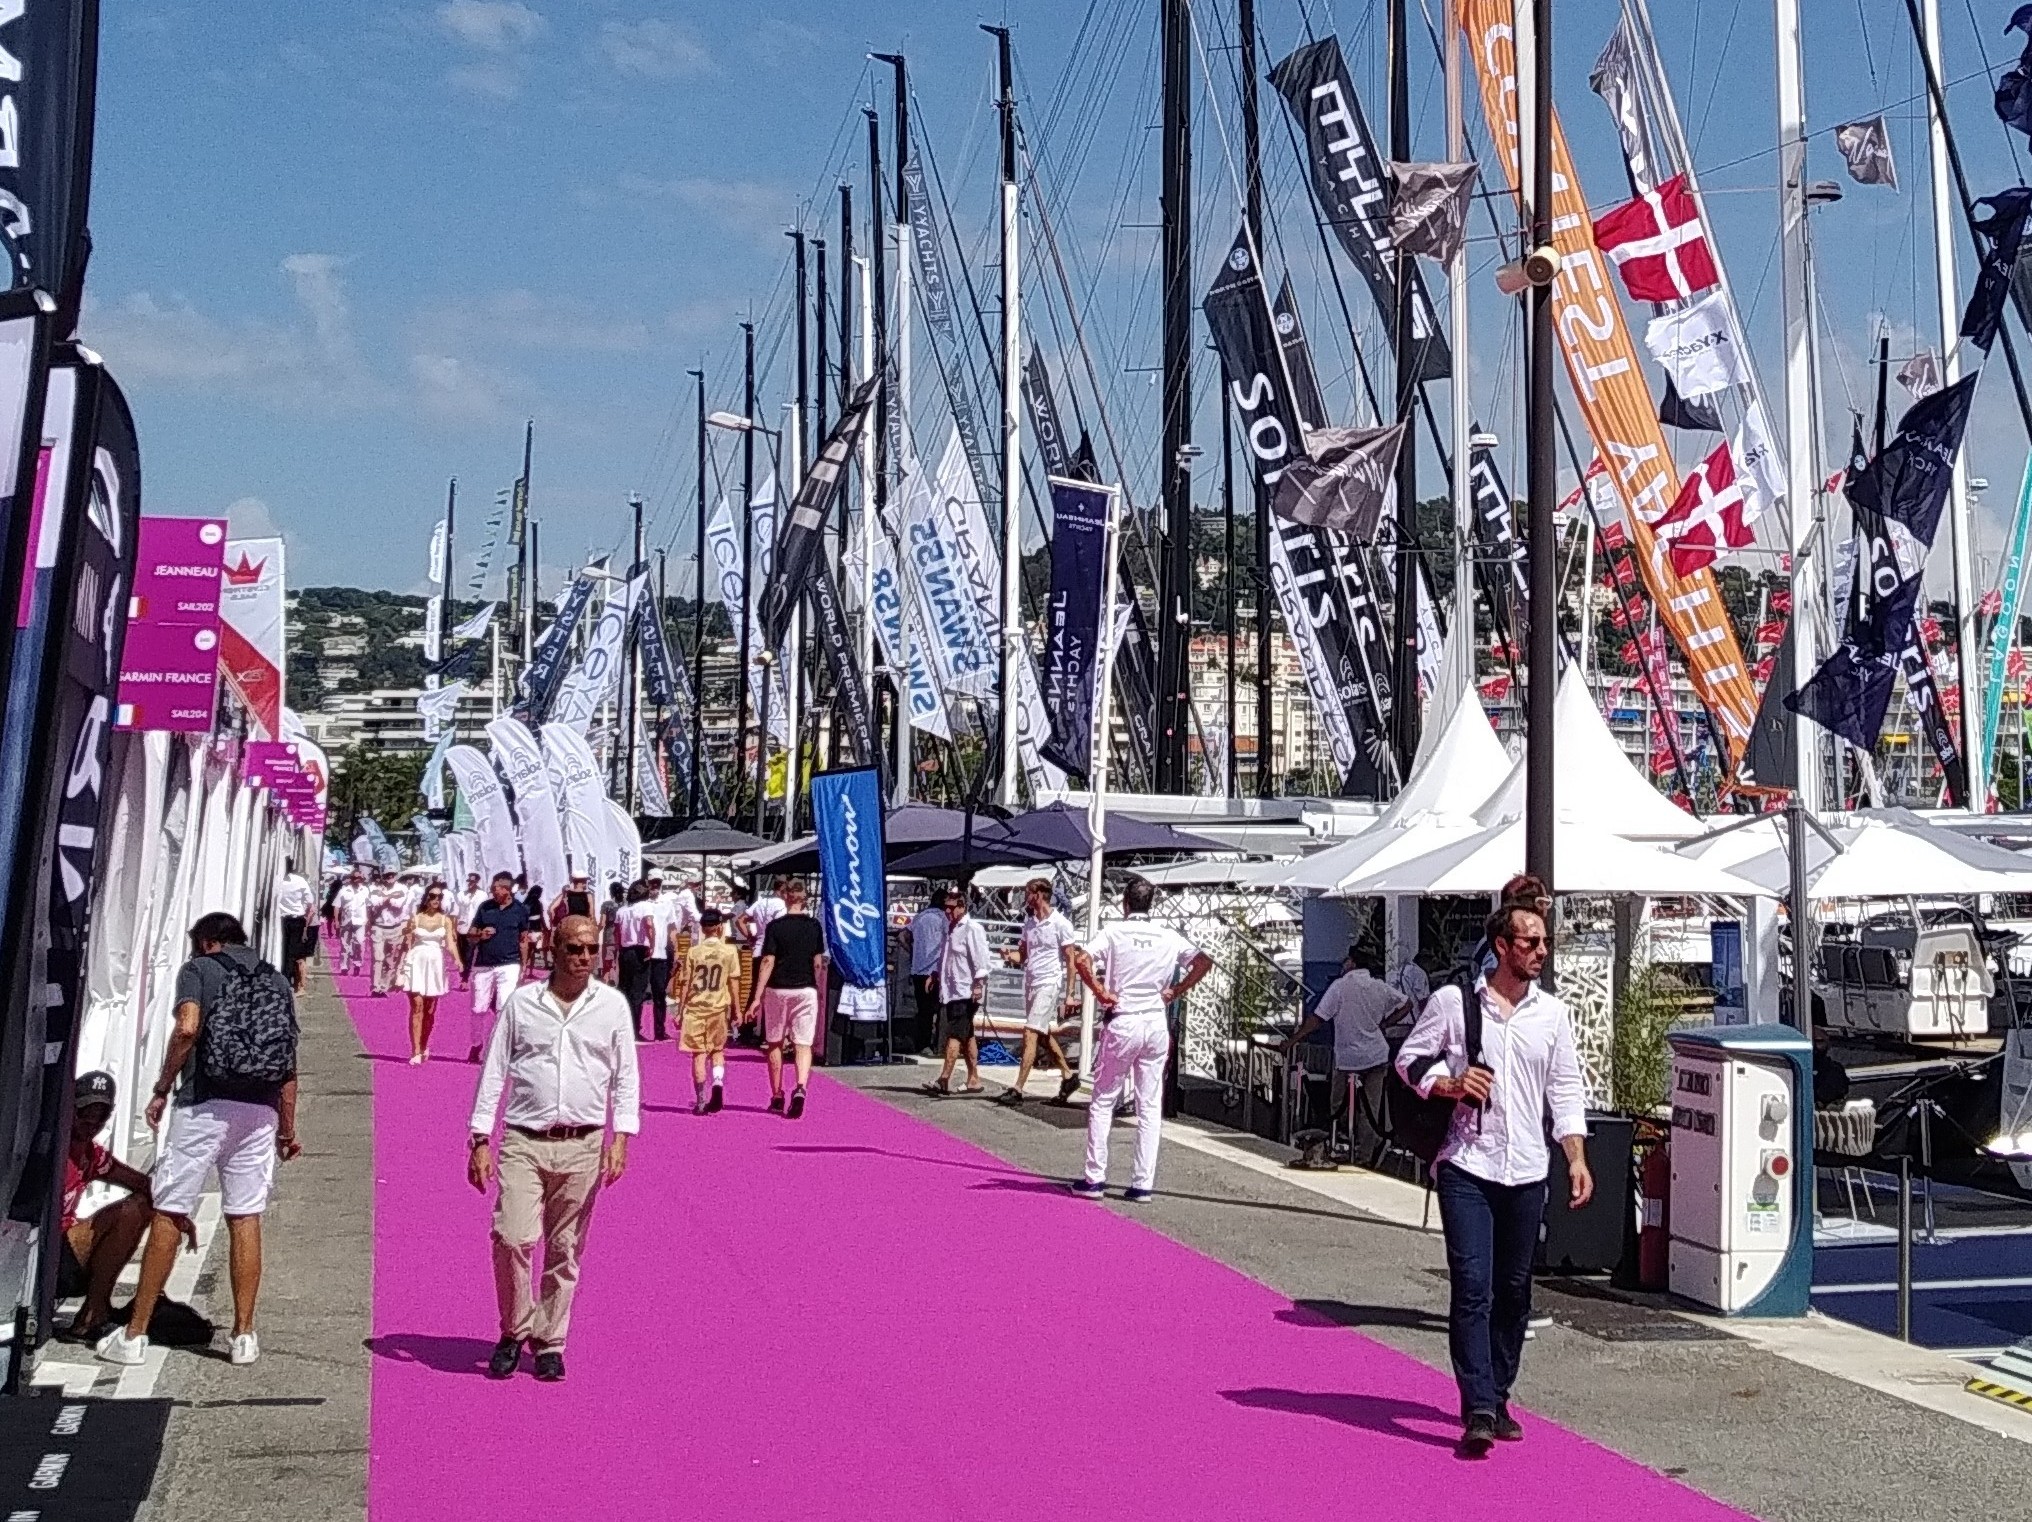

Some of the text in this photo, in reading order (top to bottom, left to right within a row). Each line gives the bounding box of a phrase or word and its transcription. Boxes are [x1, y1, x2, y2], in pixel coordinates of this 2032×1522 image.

[1034, 394, 1064, 473] WORL
[154, 564, 218, 578] JEANNEAU
[177, 601, 214, 612] SAIL202
[815, 576, 843, 648] WORLD
[165, 672, 212, 684] FRANCE
[171, 708, 208, 720] SAIL204
[693, 963, 723, 992] 30
[50, 1404, 89, 1435] GARMIN
[27, 1452, 72, 1489] GARMIN
